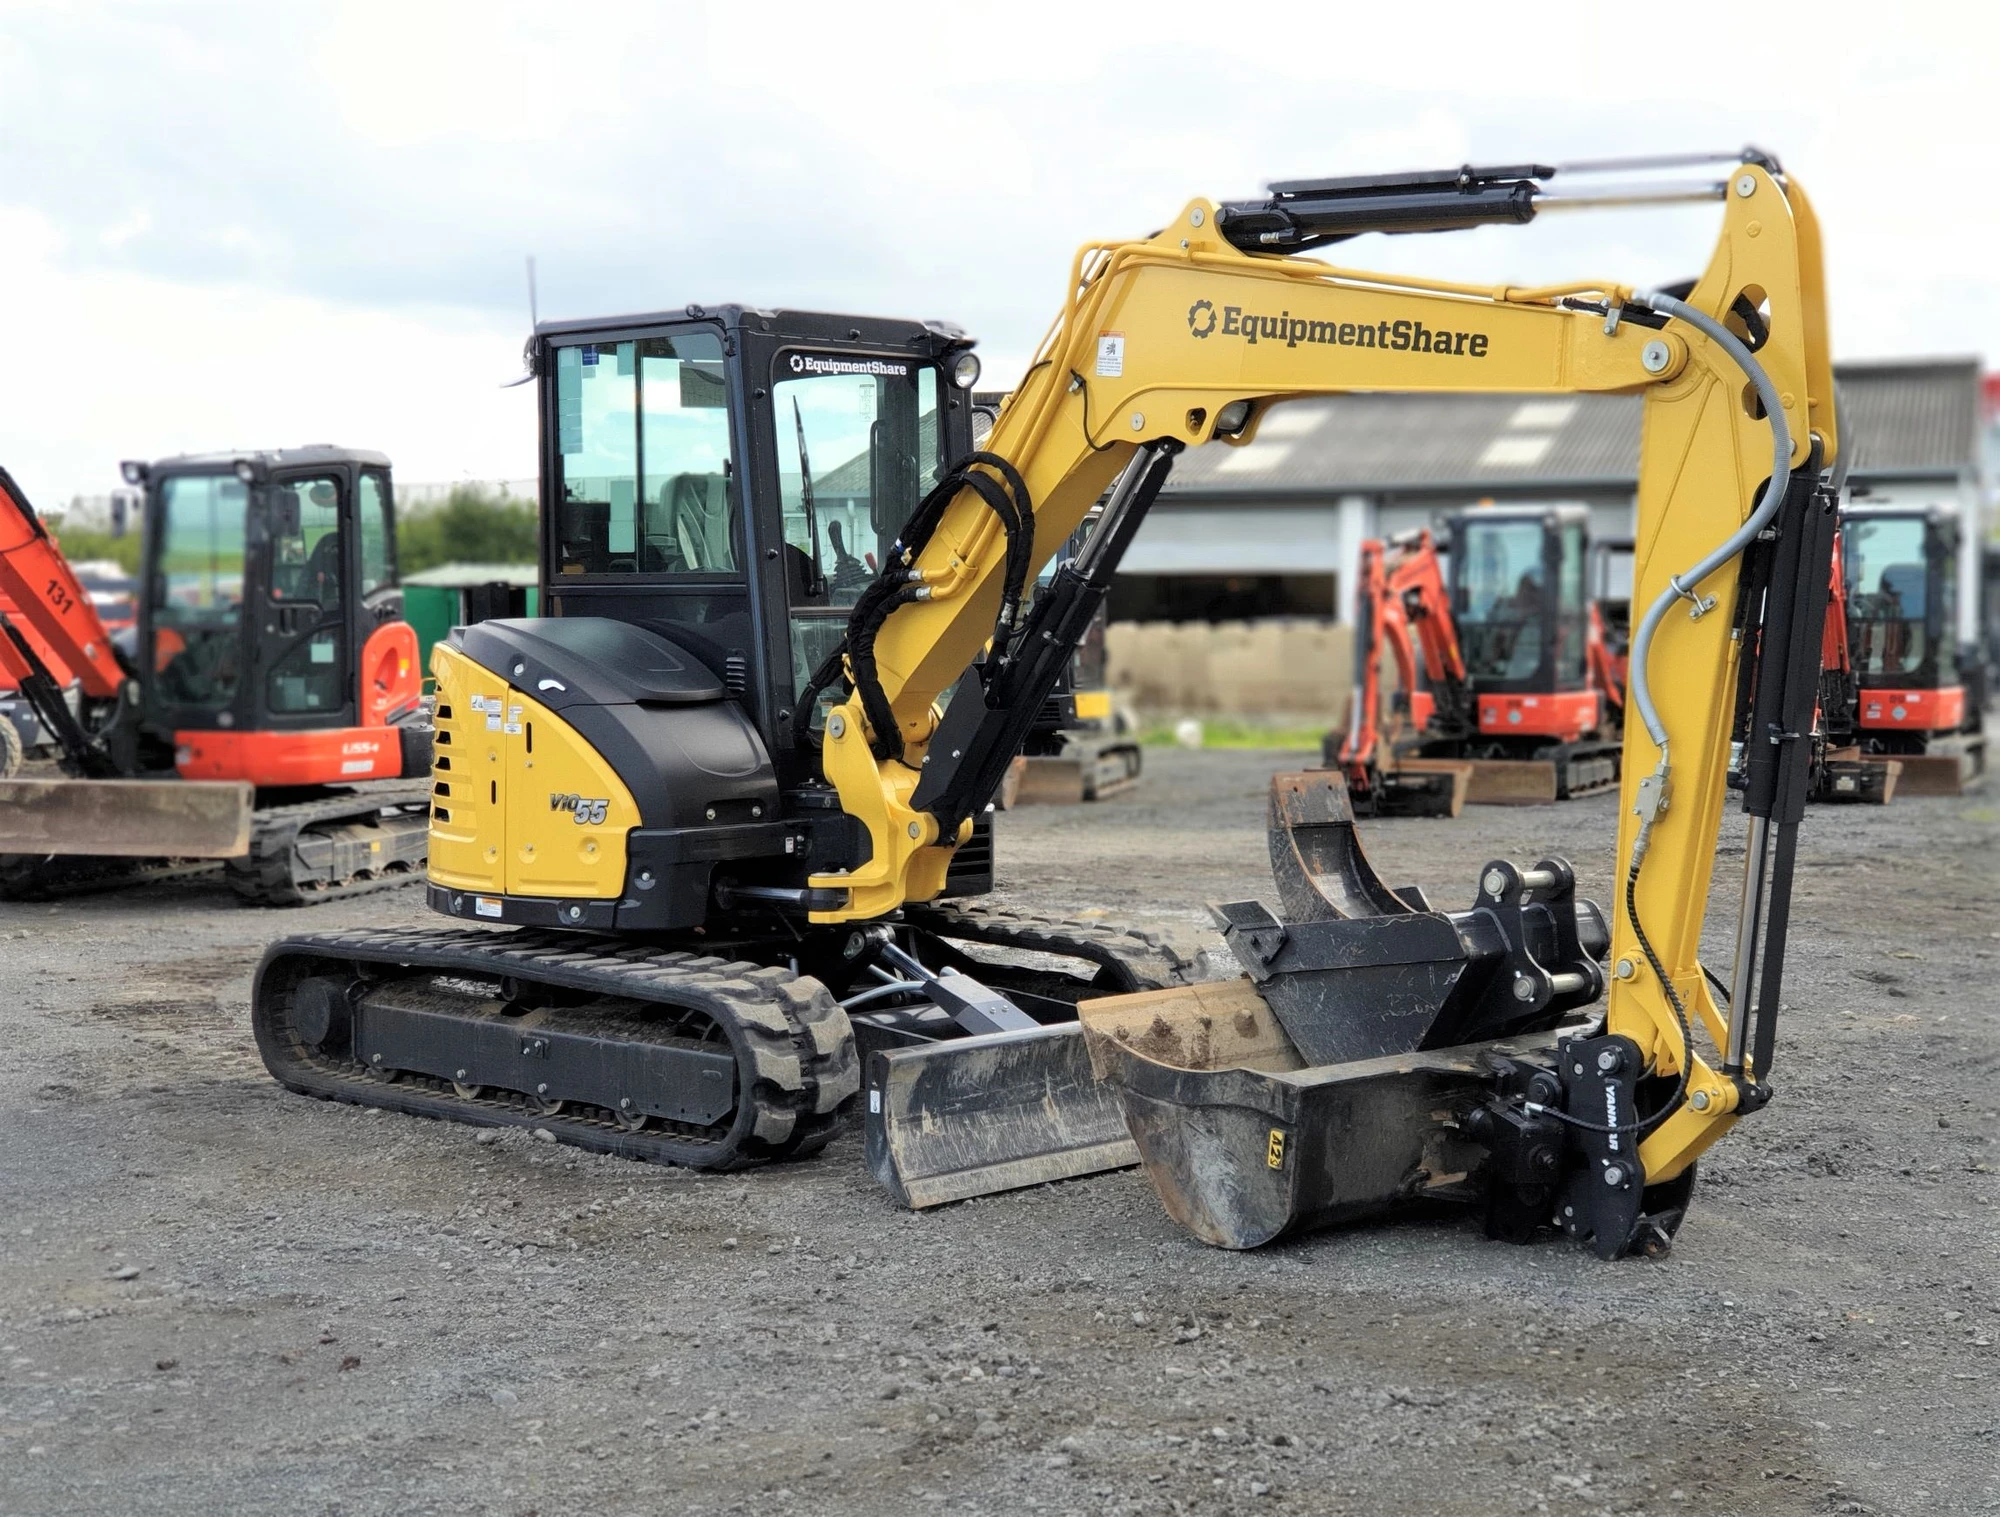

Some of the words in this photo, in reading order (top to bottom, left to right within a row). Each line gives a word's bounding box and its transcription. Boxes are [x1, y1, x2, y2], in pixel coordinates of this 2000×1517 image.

[1221, 306, 1489, 358] EquipmentShare
[804, 357, 907, 376] EquipmentShare
[46, 579, 74, 615] 131
